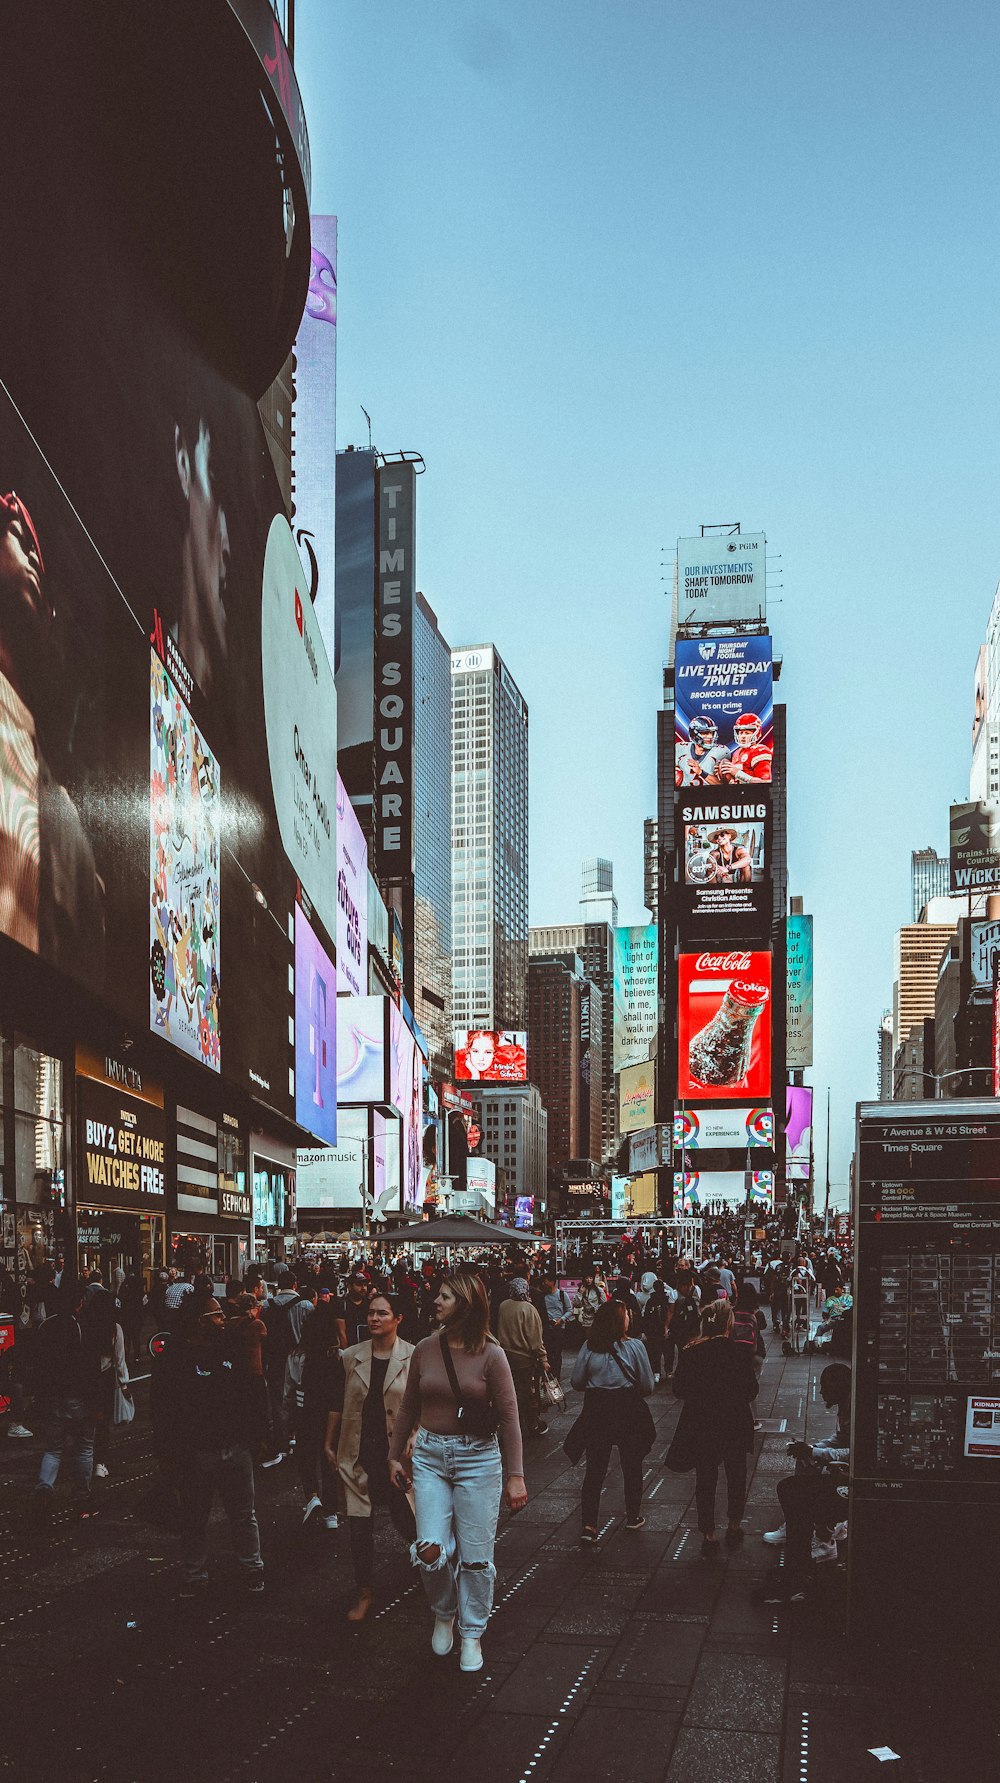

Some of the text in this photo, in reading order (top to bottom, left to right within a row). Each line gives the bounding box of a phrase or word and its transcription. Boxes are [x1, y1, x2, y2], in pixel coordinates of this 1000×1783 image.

[739, 542, 758, 551] PGIM
[380, 485, 405, 638] TIMES
[685, 563, 753, 577] OUR INVESTMENTS
[685, 574, 754, 588] SHAPE TOMORROW
[685, 588, 709, 599] TODAY
[678, 661, 771, 678] LIVE THURSDAY
[702, 674, 747, 687] 7PM ET
[690, 690, 726, 700] BRONCOS
[733, 688, 758, 698] CHIEFS
[722, 702, 742, 712] prime
[379, 661, 404, 851] SQUARE
[682, 804, 767, 822] SAMSUNG
[957, 849, 985, 859] Brains.
[788, 930, 801, 940] the
[629, 942, 641, 950] am
[643, 940, 655, 949] the
[790, 942, 799, 952] of
[627, 951, 654, 964] light of
[622, 963, 658, 974] the world
[624, 977, 655, 986] whoever
[734, 979, 767, 993] Coke
[624, 988, 656, 998] believes
[628, 1000, 652, 1010] in me,
[789, 1004, 802, 1014] not
[623, 1011, 656, 1022] shall not
[791, 1016, 799, 1026] in
[626, 1023, 654, 1034] walk in
[882, 1125, 987, 1137] 7 Avenue & W 45 Street
[85, 1118, 164, 1163] BUY 2, GET 4 MORE
[882, 1143, 943, 1153] Times Square
[327, 1151, 357, 1162] music
[86, 1151, 165, 1195] WATCHES FREE
[222, 1192, 250, 1214] SEPHORA
